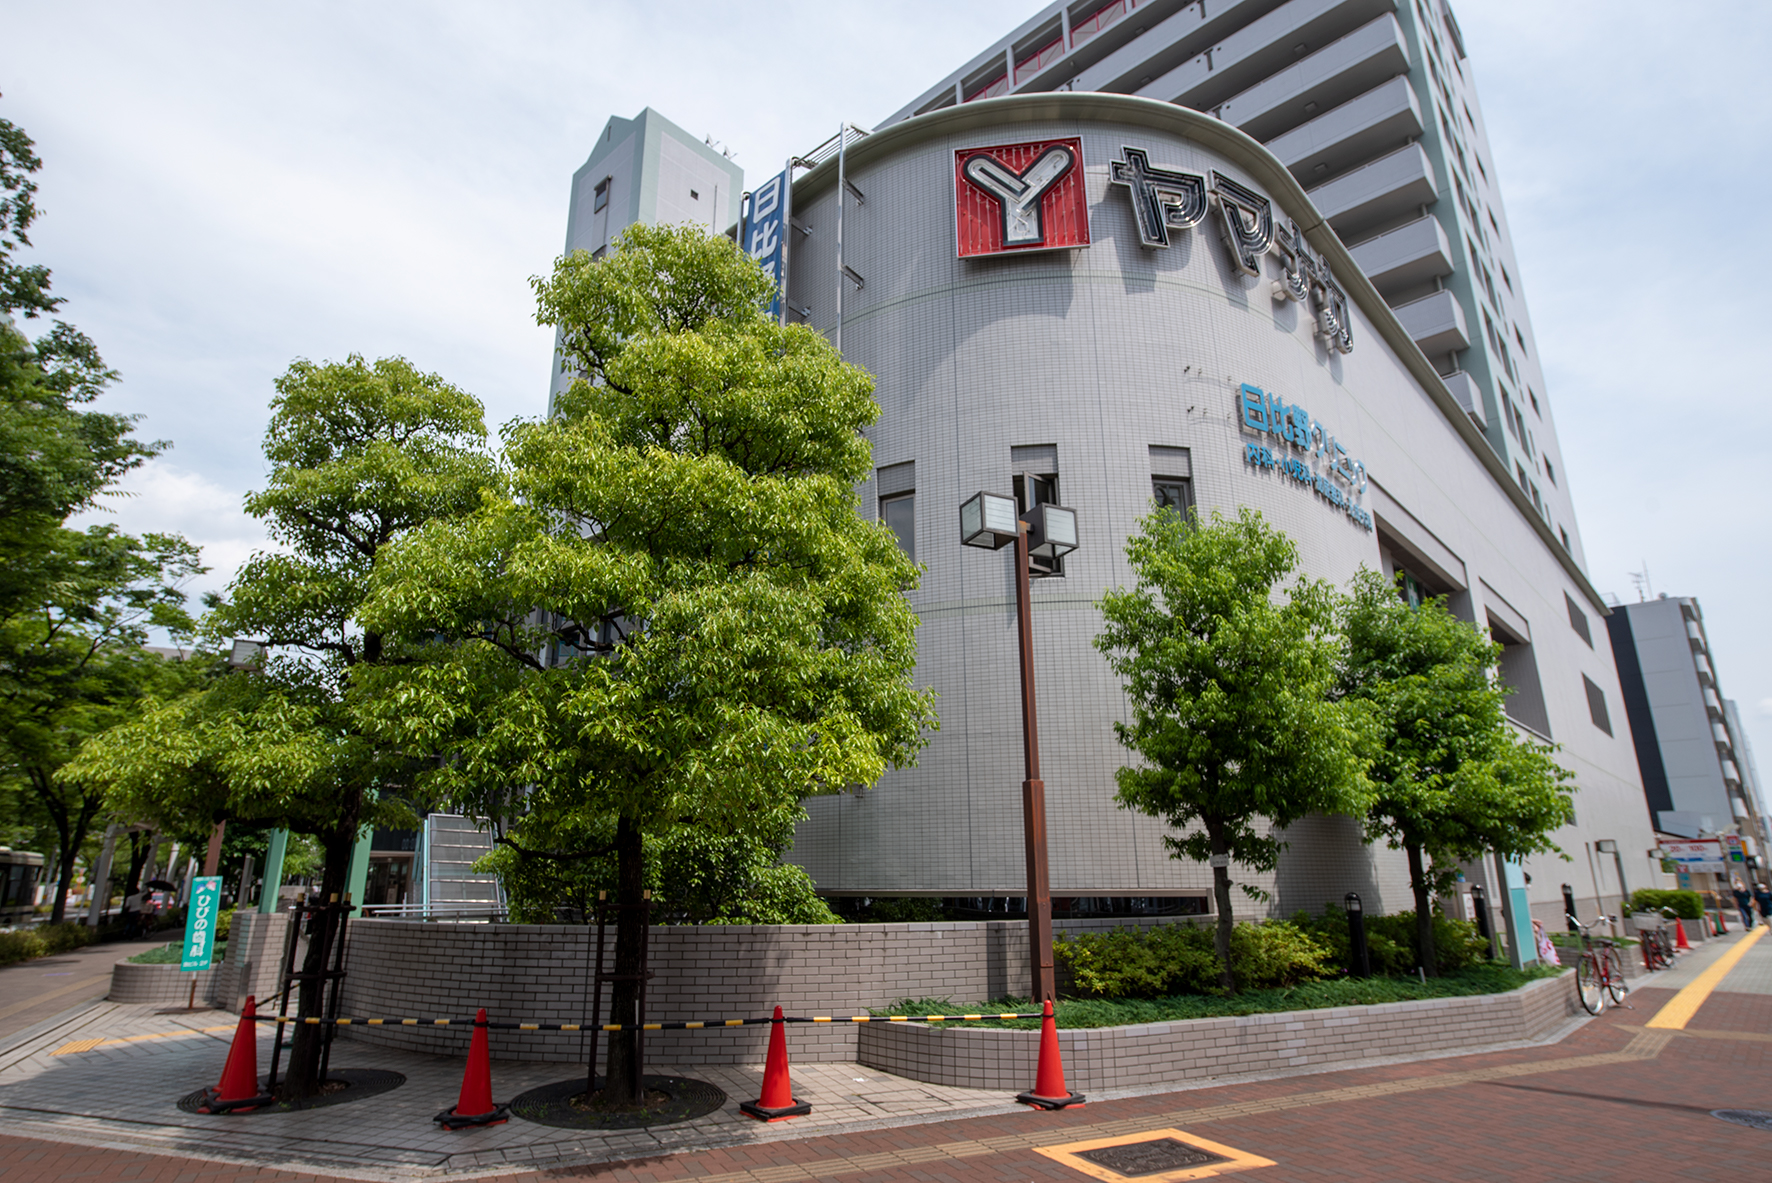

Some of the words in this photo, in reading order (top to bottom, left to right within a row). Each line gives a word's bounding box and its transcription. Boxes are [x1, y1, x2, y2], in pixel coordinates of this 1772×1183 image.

[1109, 144, 1354, 355] ヤマナカ
[1240, 382, 1368, 495] 日比野クリニック
